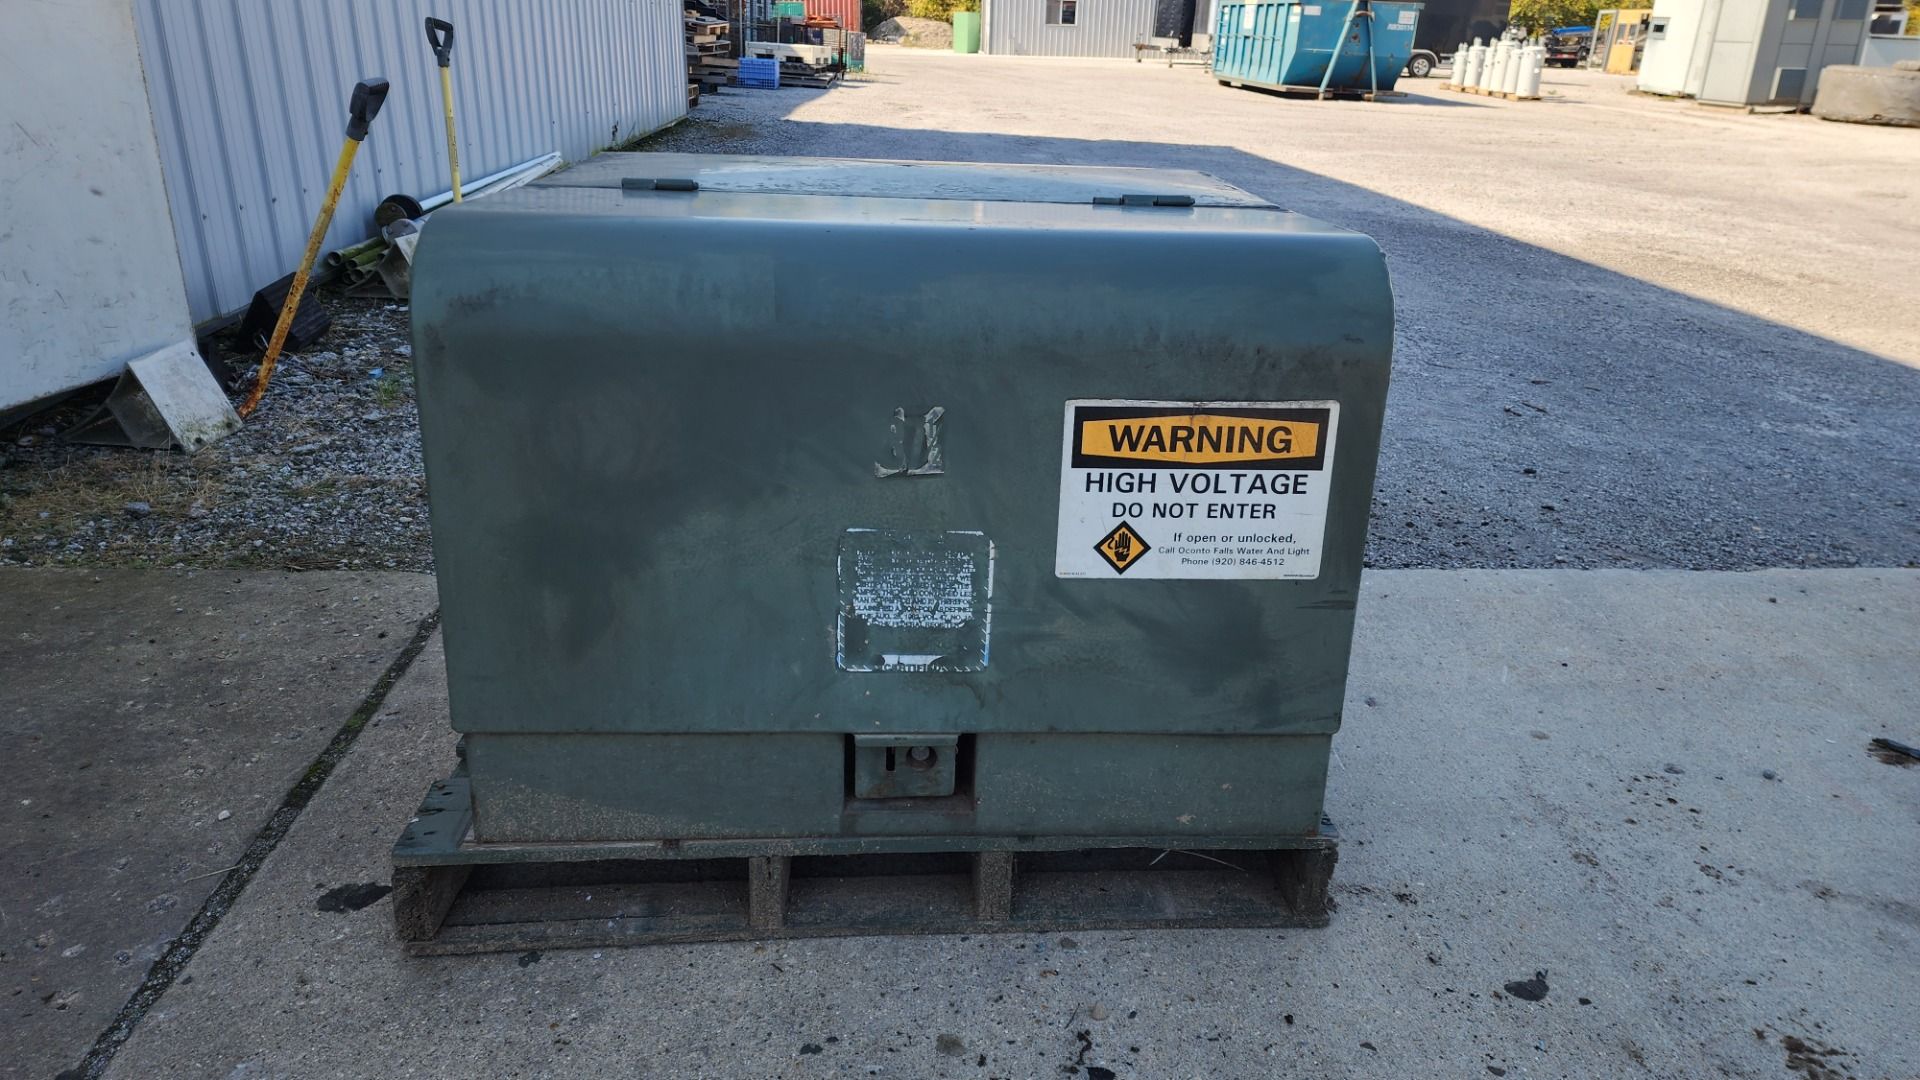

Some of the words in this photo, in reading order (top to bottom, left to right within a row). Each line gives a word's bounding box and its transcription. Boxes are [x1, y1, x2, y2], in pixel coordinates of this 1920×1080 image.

[1109, 425, 1292, 453] WARNING
[1085, 472, 1157, 493] HIGH
[1169, 473, 1309, 495] VOLTAGE
[1112, 502, 1143, 518] DO
[1152, 502, 1199, 519] NOT
[1206, 503, 1276, 519] ENTER
[1173, 532, 1182, 543] If
[1186, 535, 1216, 544] open
[1237, 533, 1297, 544] unlocked,
[1158, 546, 1175, 554] Call
[1213, 547, 1234, 555] Falls
[1267, 547, 1285, 555] And
[1287, 547, 1310, 556] Light
[1181, 557, 1209, 566] Phone
[1211, 558, 1236, 566] (920)
[1239, 558, 1285, 566] 846-4512
